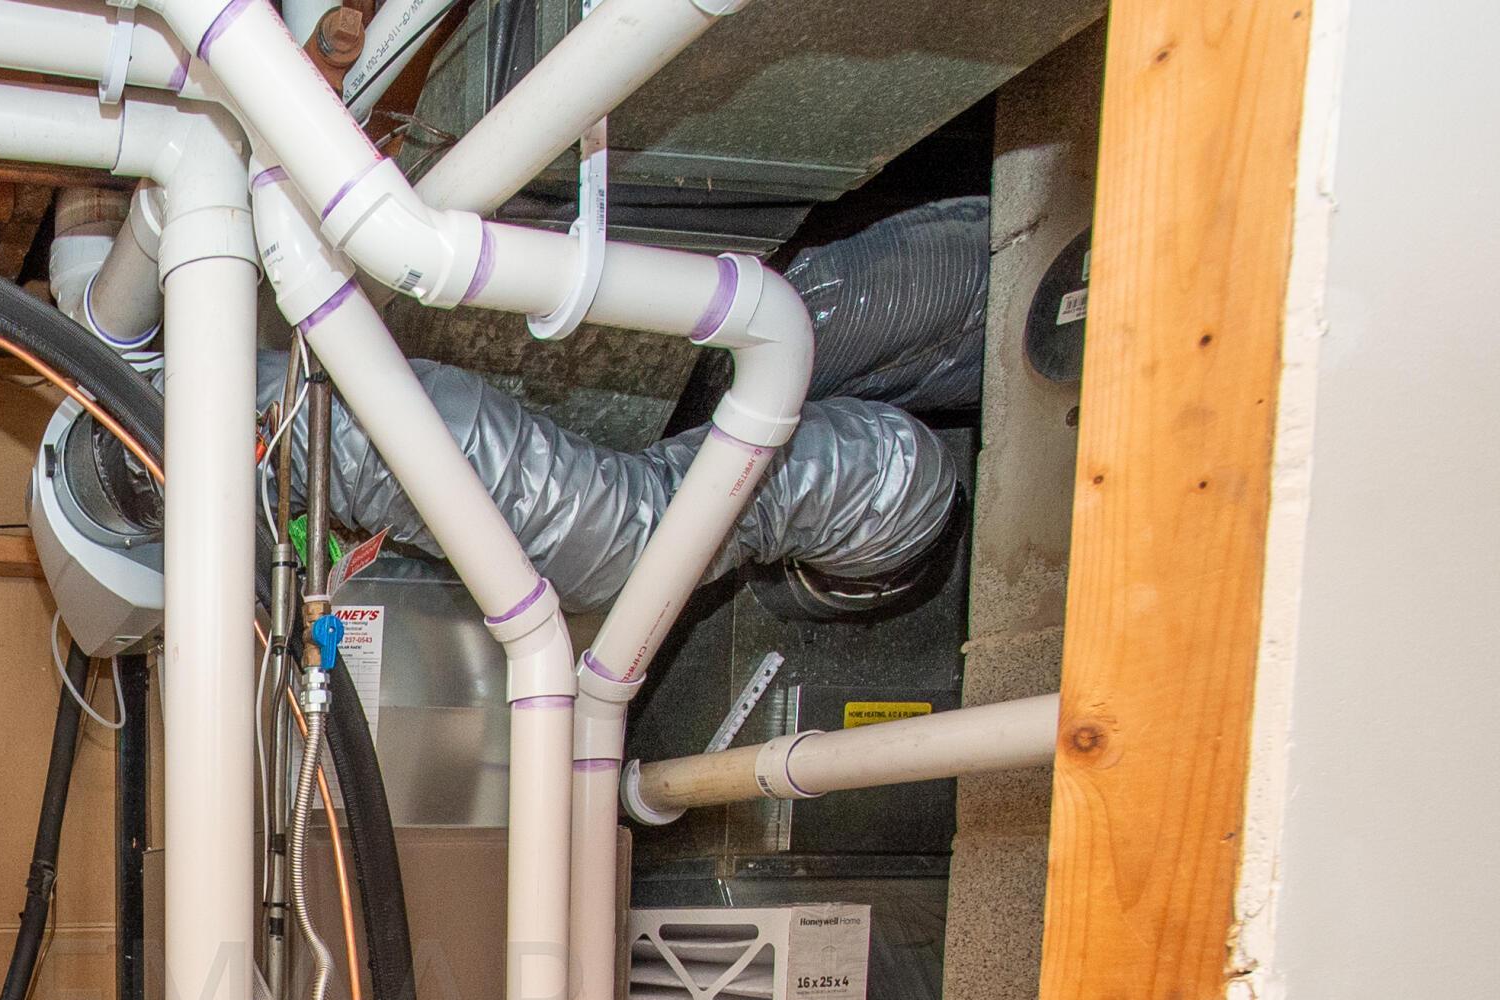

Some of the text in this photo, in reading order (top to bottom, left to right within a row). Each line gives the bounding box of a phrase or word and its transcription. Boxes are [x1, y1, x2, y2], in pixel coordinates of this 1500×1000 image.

[334, 609, 379, 621] ANEY'S
[800, 917, 861, 927] Honeywell Home
[797, 976, 849, 988] 16 x 25 x 4
